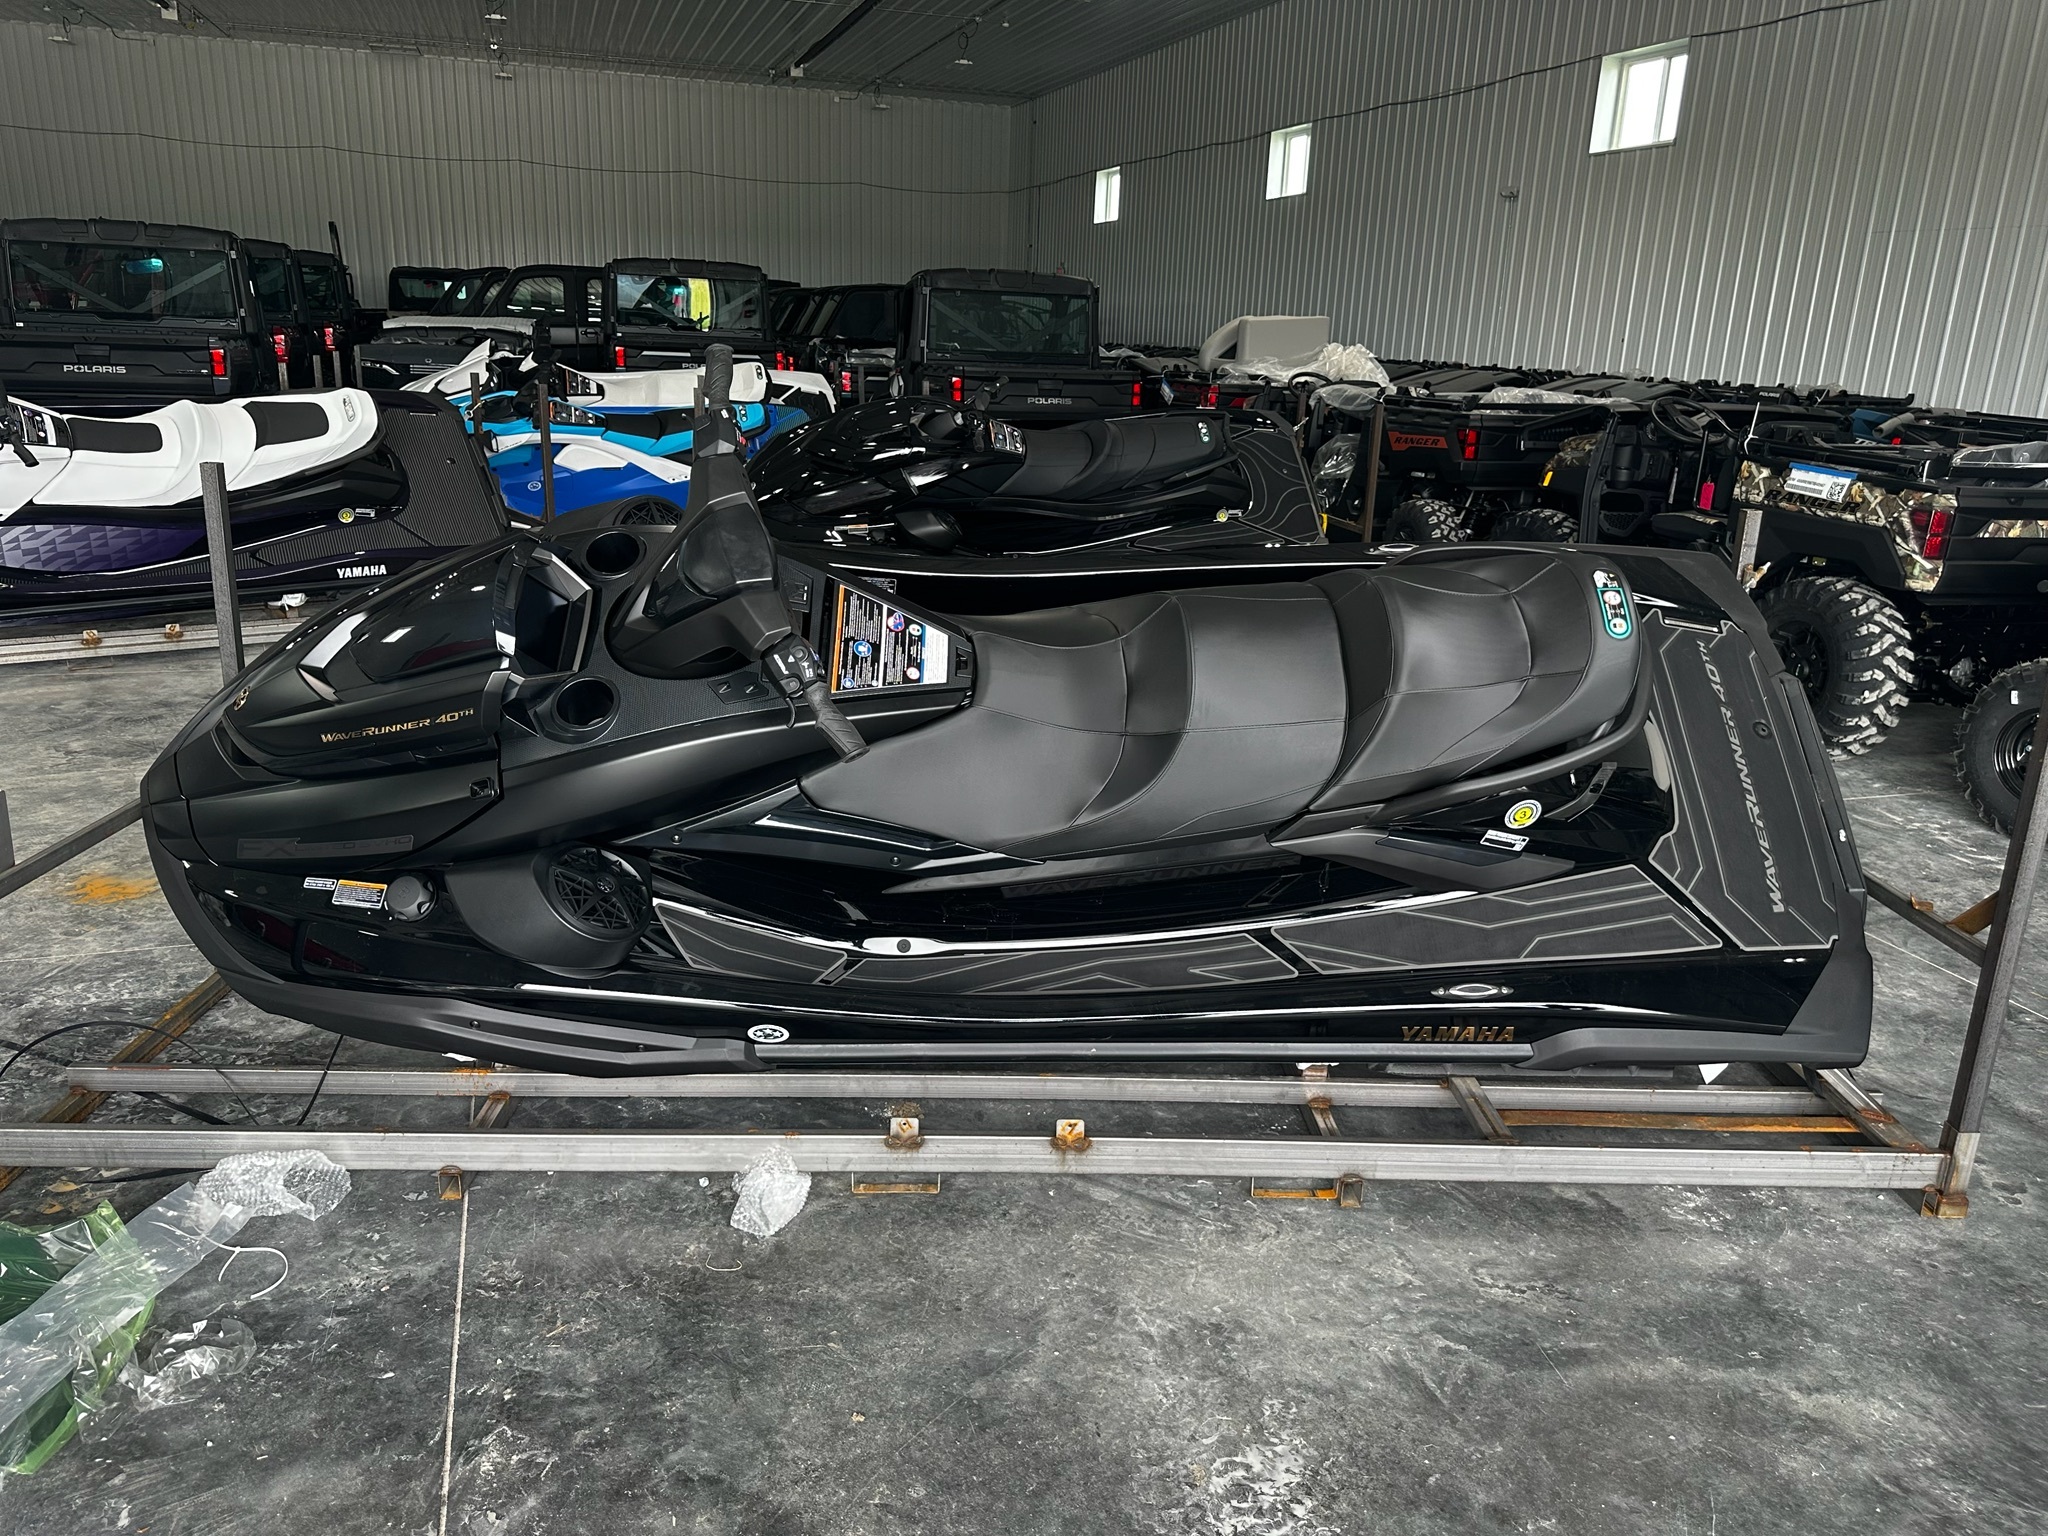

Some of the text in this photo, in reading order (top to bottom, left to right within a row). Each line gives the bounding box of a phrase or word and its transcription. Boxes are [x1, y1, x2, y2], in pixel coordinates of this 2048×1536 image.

[63, 364, 127, 374] POLARIS
[1027, 397, 1072, 405] POLARIS
[1394, 436, 1440, 447] RANGER
[1763, 489, 1862, 515] RANGER
[336, 564, 387, 579] YAMAHA
[320, 707, 474, 743] WAVERUNNER 40TH
[1696, 640, 1784, 913] WAVERUNNER 40TH
[1401, 1026, 1515, 1042] YAMAHA
